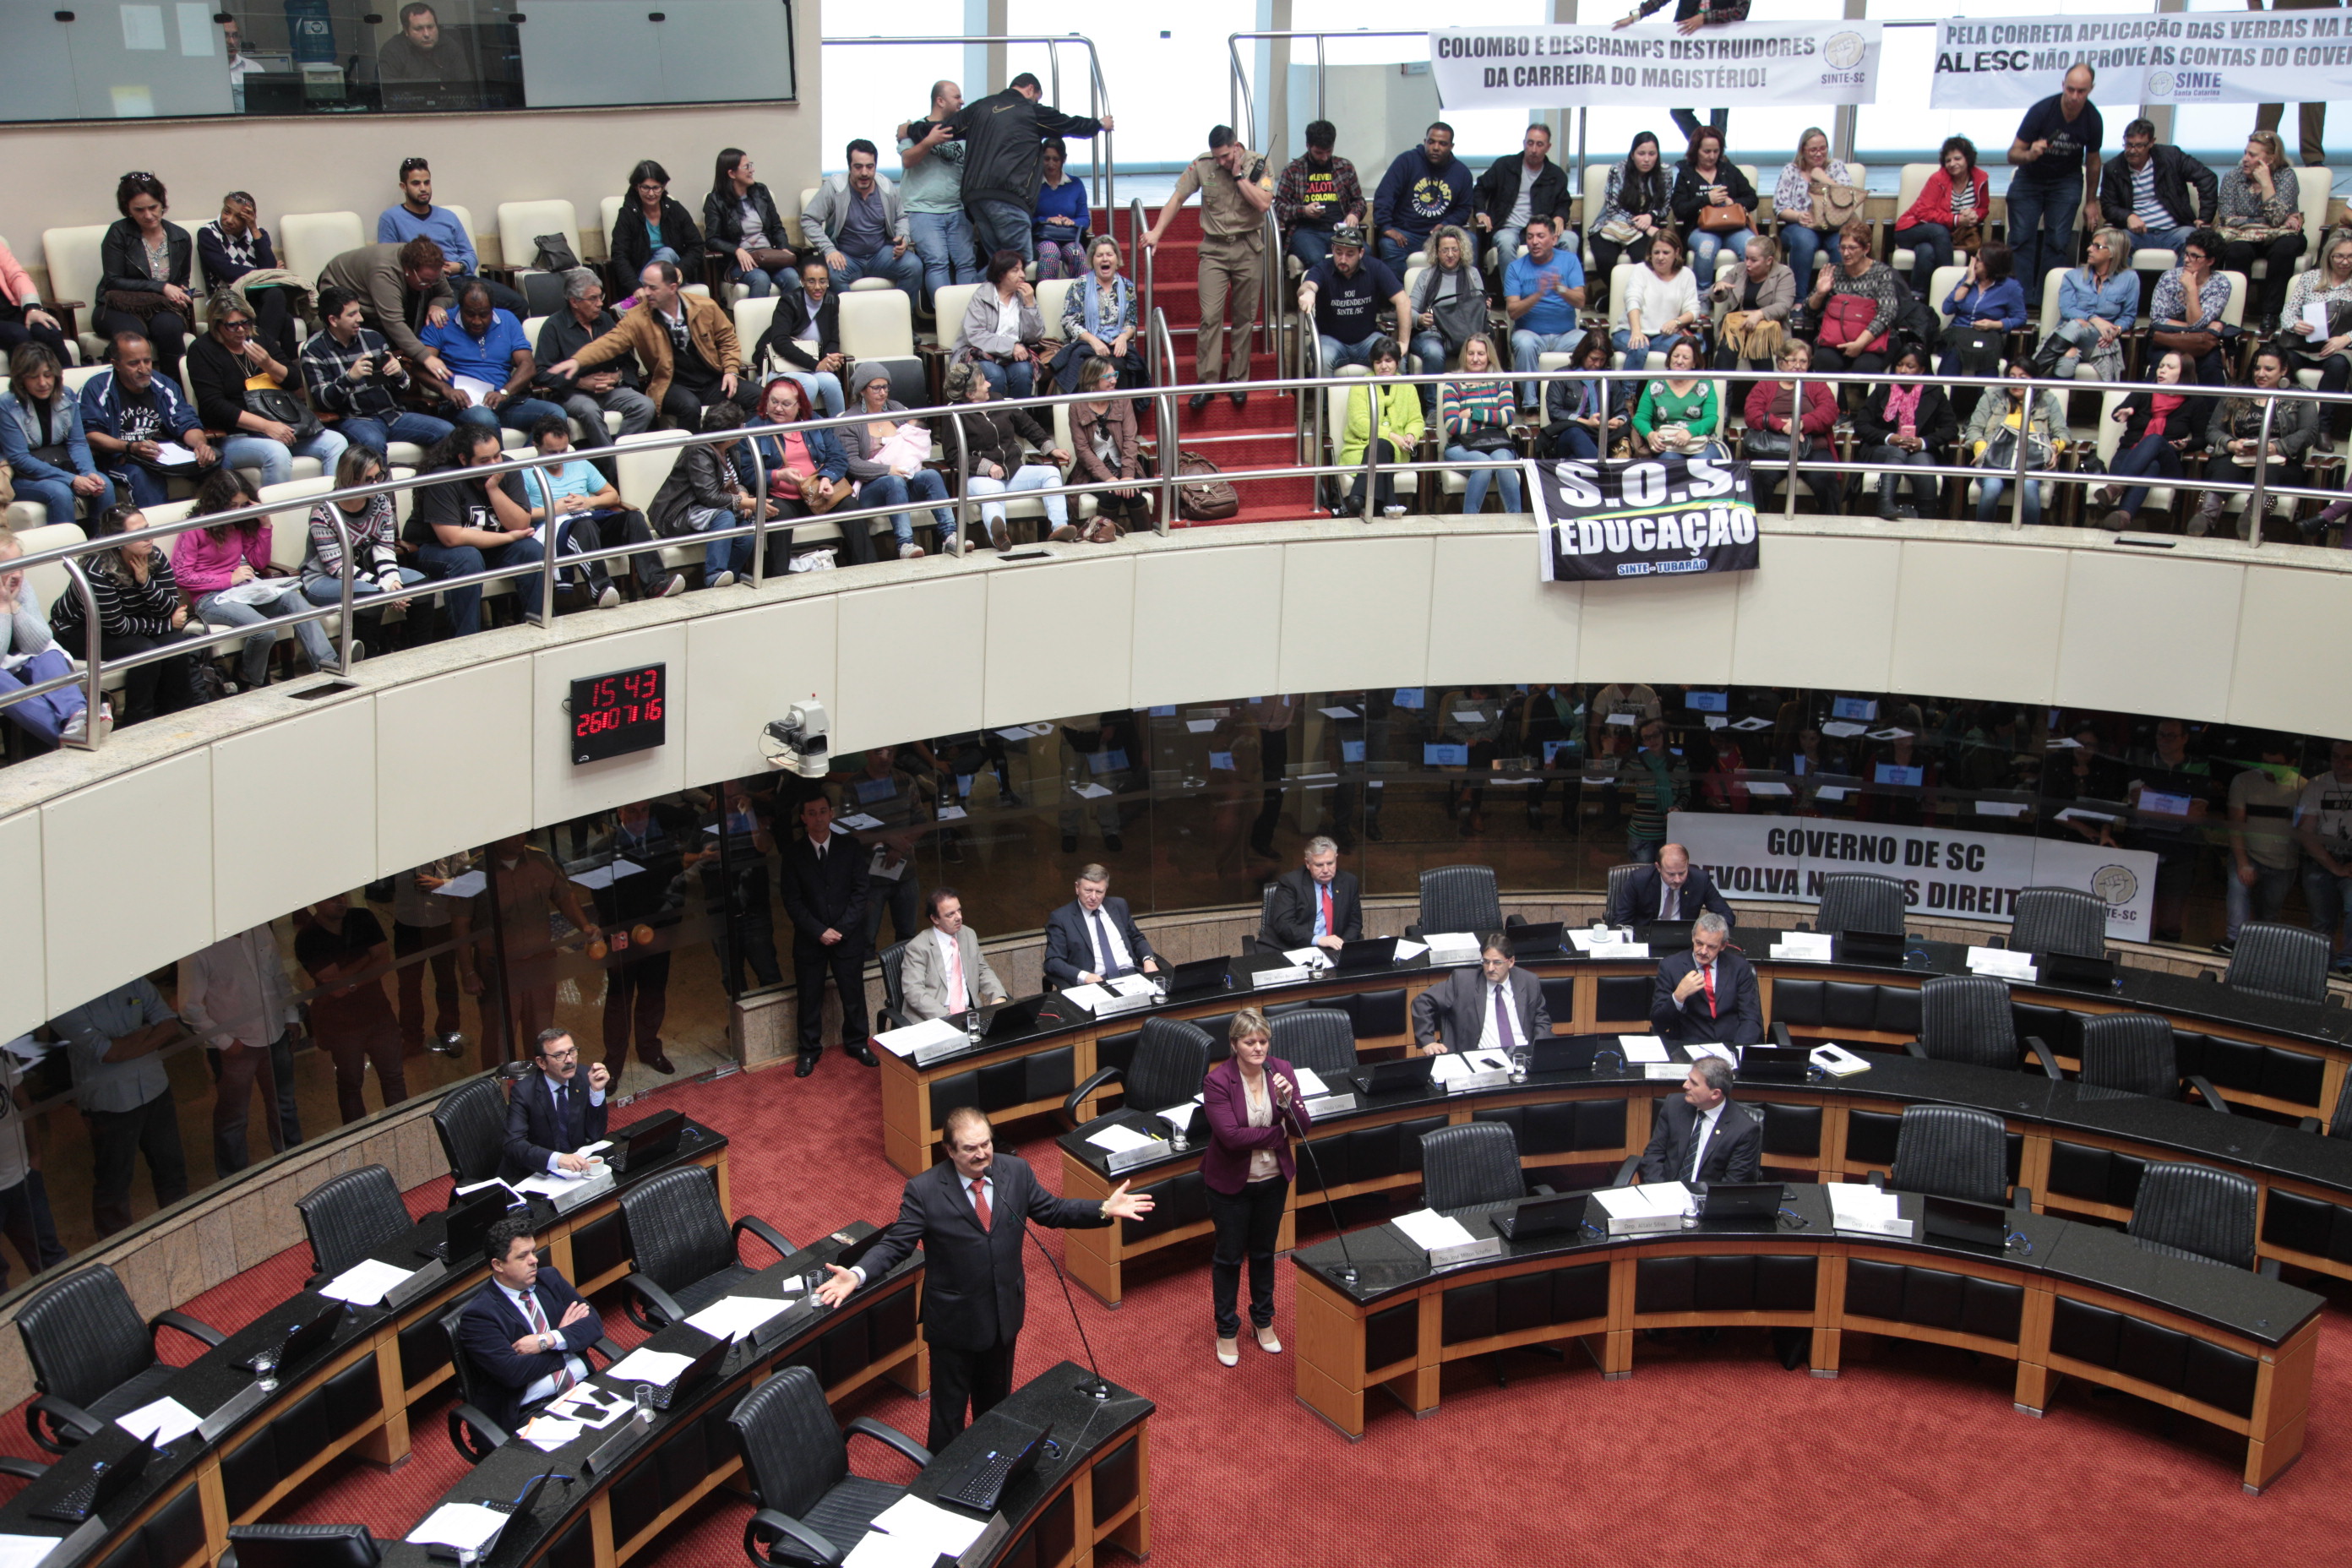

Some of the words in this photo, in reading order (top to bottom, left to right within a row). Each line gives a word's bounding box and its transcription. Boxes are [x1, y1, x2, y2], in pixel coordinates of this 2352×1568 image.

[1946, 25, 1988, 46] PELA
[1991, 24, 2072, 45] CORRETA
[2077, 19, 2182, 42] APLICAÇÃO
[2186, 22, 2224, 40] DAS
[2230, 19, 2307, 39] VERBAS
[2311, 17, 2339, 37] NA
[1438, 35, 1532, 59] COLOMBO
[1534, 36, 1544, 57] E
[1549, 35, 1665, 59] DESCHAMPS
[1669, 36, 1816, 60] DESTRUIDORES
[2032, 46, 2071, 71] NÃO
[2075, 46, 2147, 68] APROVE
[2150, 46, 2175, 66] AS
[2180, 46, 2256, 68] CONTAS
[2261, 47, 2289, 68] DO
[1484, 67, 1509, 88] DA
[1514, 65, 1606, 88] CARREIRA
[1611, 66, 1636, 87] DO
[1642, 65, 1767, 89] MAGISTÉRIO!
[1821, 72, 1865, 84] SINTE-SC
[2175, 72, 2223, 89] SINTE
[1331, 296, 1372, 307] INDEPENDENTE
[1344, 290, 1356, 298] SOU
[1554, 459, 1747, 509] S.O.S.
[1557, 502, 1756, 557] EDUCAÇÃO
[1767, 827, 1897, 866] GOVERNO
[1905, 838, 1941, 869] DE
[1946, 843, 1986, 873] SC
